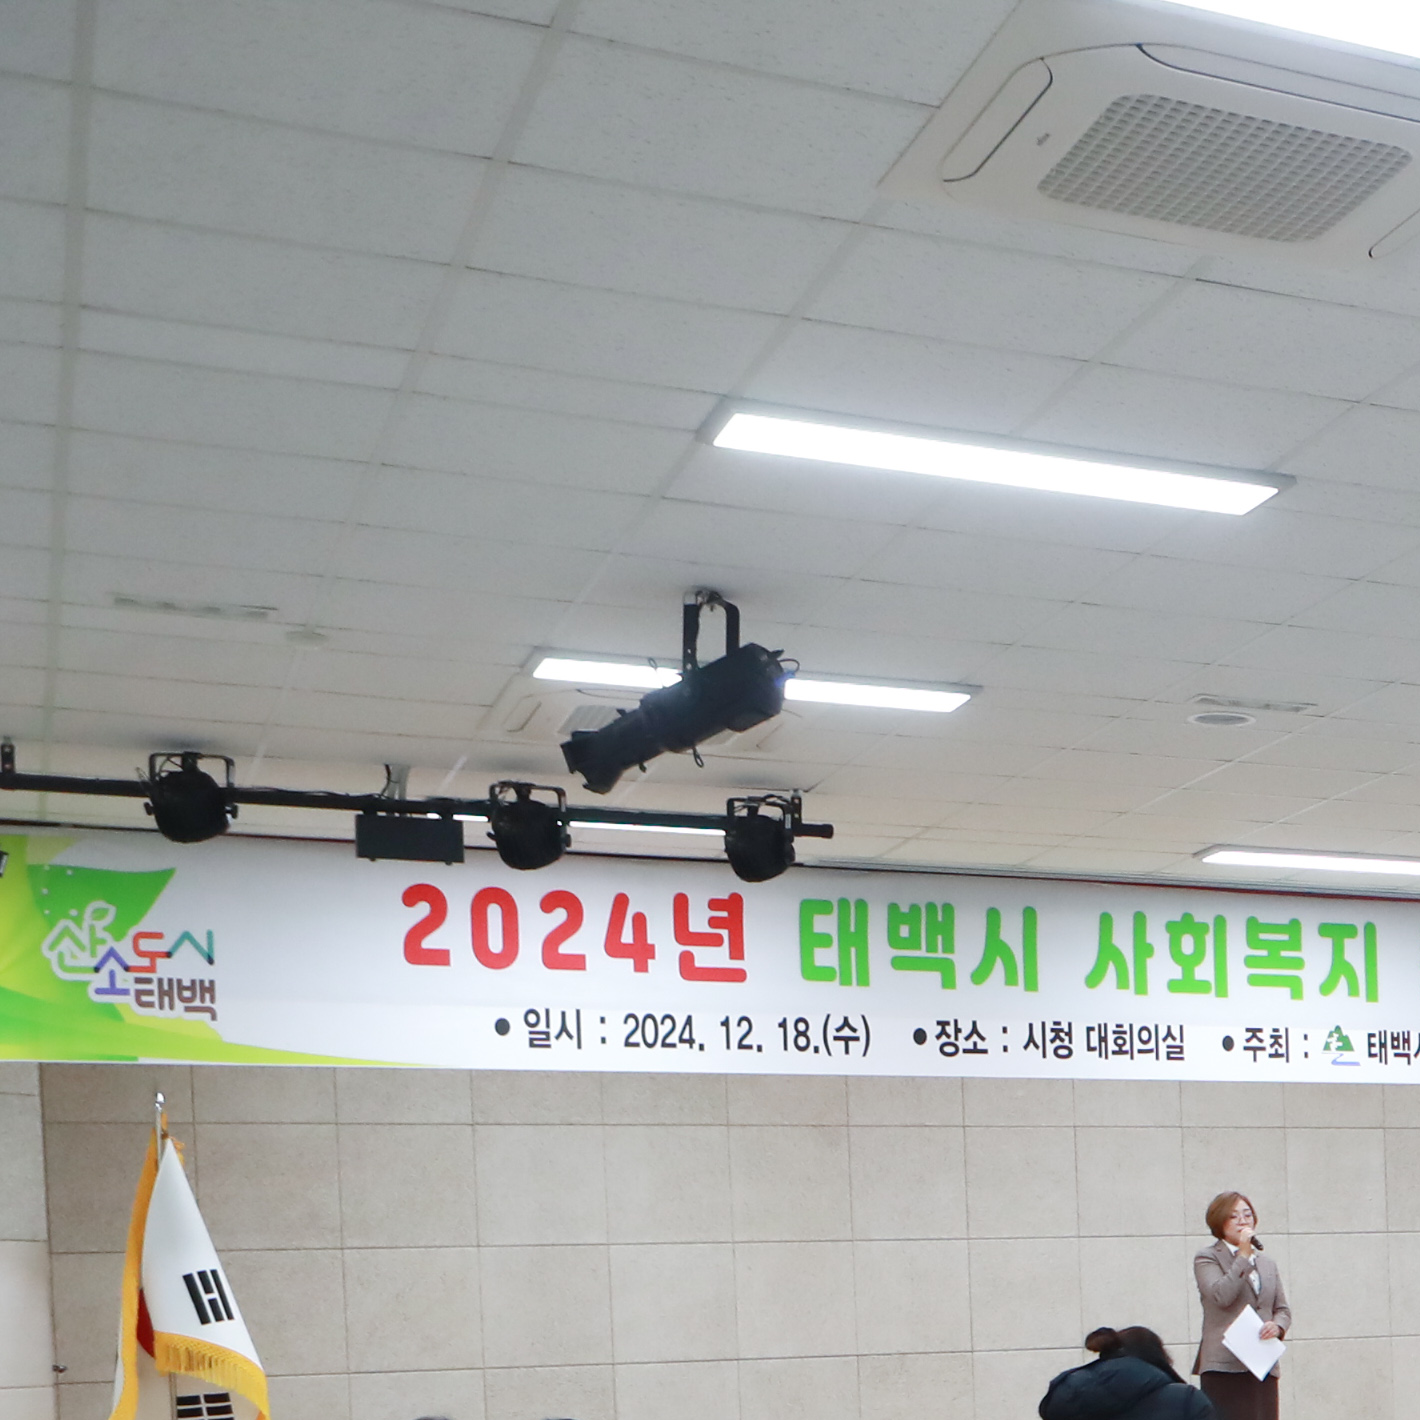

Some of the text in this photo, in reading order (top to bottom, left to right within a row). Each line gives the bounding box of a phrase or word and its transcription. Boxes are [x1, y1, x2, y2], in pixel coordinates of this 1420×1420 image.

[401, 883, 747, 983] 2024년
[800, 898, 1039, 992] 태백시
[1086, 911, 1379, 1003] 사회복지
[134, 977, 216, 1021] 태백
[624, 1014, 705, 1051] 2024.
[720, 1016, 763, 1053] 12.
[1023, 1021, 1073, 1059] 시청
[1086, 1023, 1184, 1061] 대회의실
